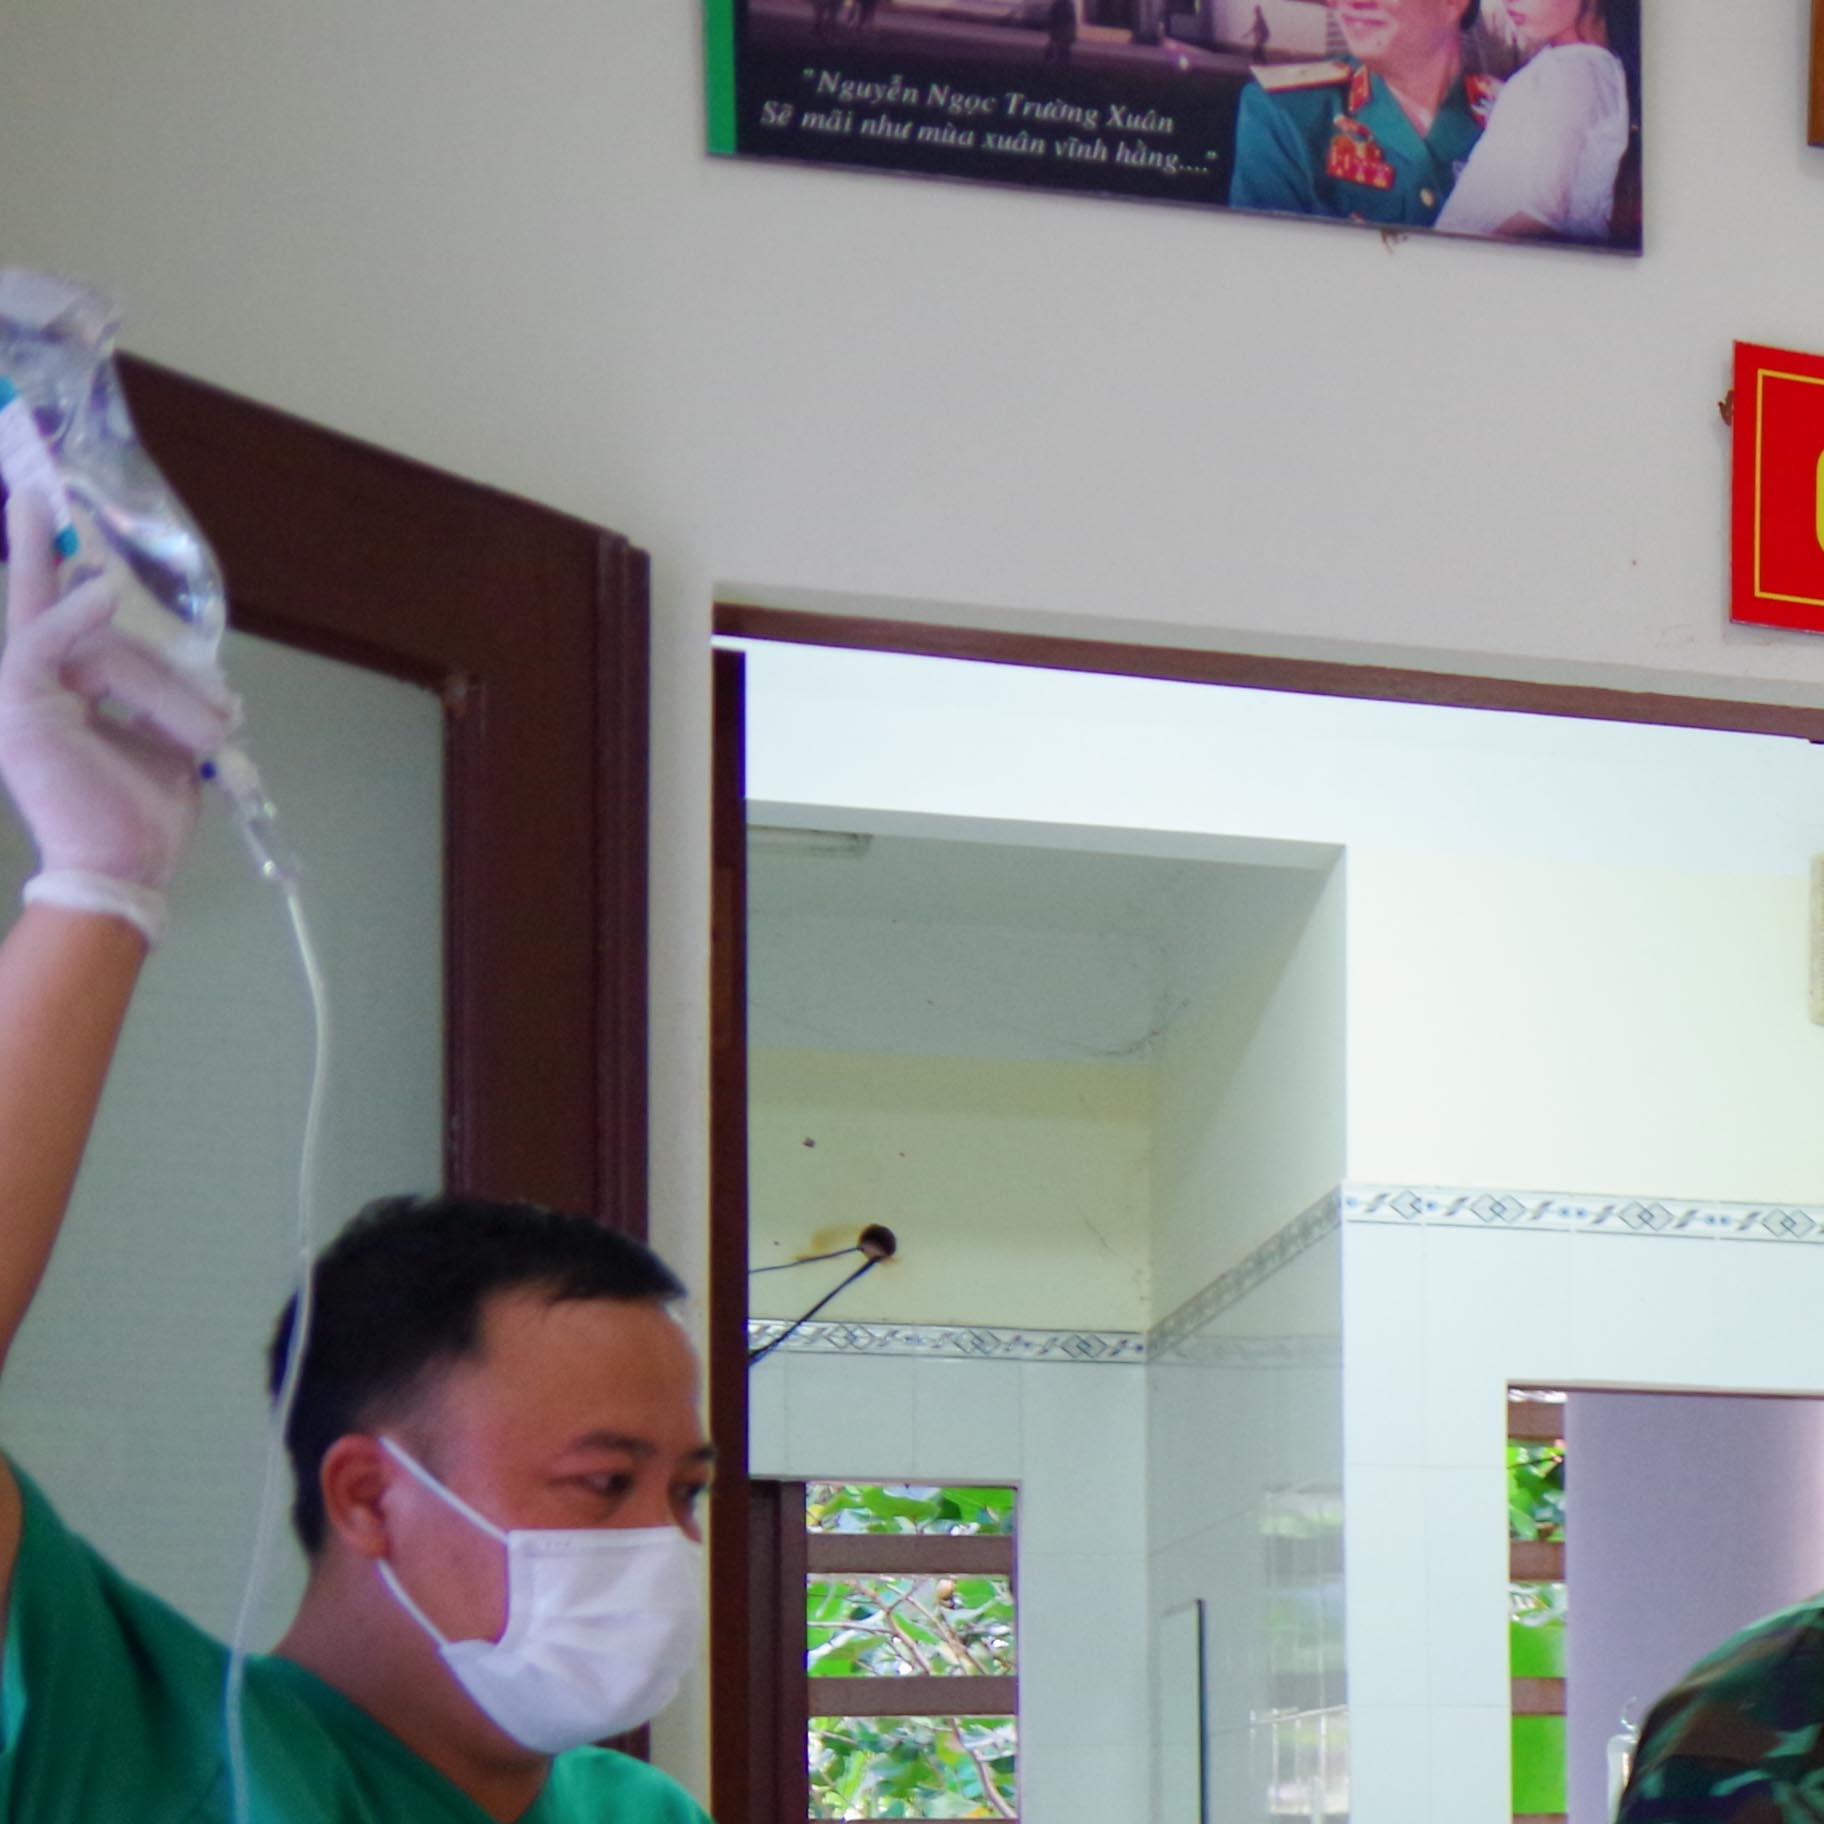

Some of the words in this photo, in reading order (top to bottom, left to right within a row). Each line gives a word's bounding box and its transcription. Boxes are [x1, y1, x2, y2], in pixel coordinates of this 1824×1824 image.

[760, 100, 793, 126] Sẽ
[802, 108, 853, 132] mãi
[861, 112, 913, 138] như
[918, 121, 974, 147] mùa
[980, 127, 1045, 155] xuân
[1054, 136, 1108, 161] vĩnh
[927, 83, 996, 114] Ngọc
[1005, 91, 1099, 130] Trường
[1106, 104, 1174, 133] Xuân
